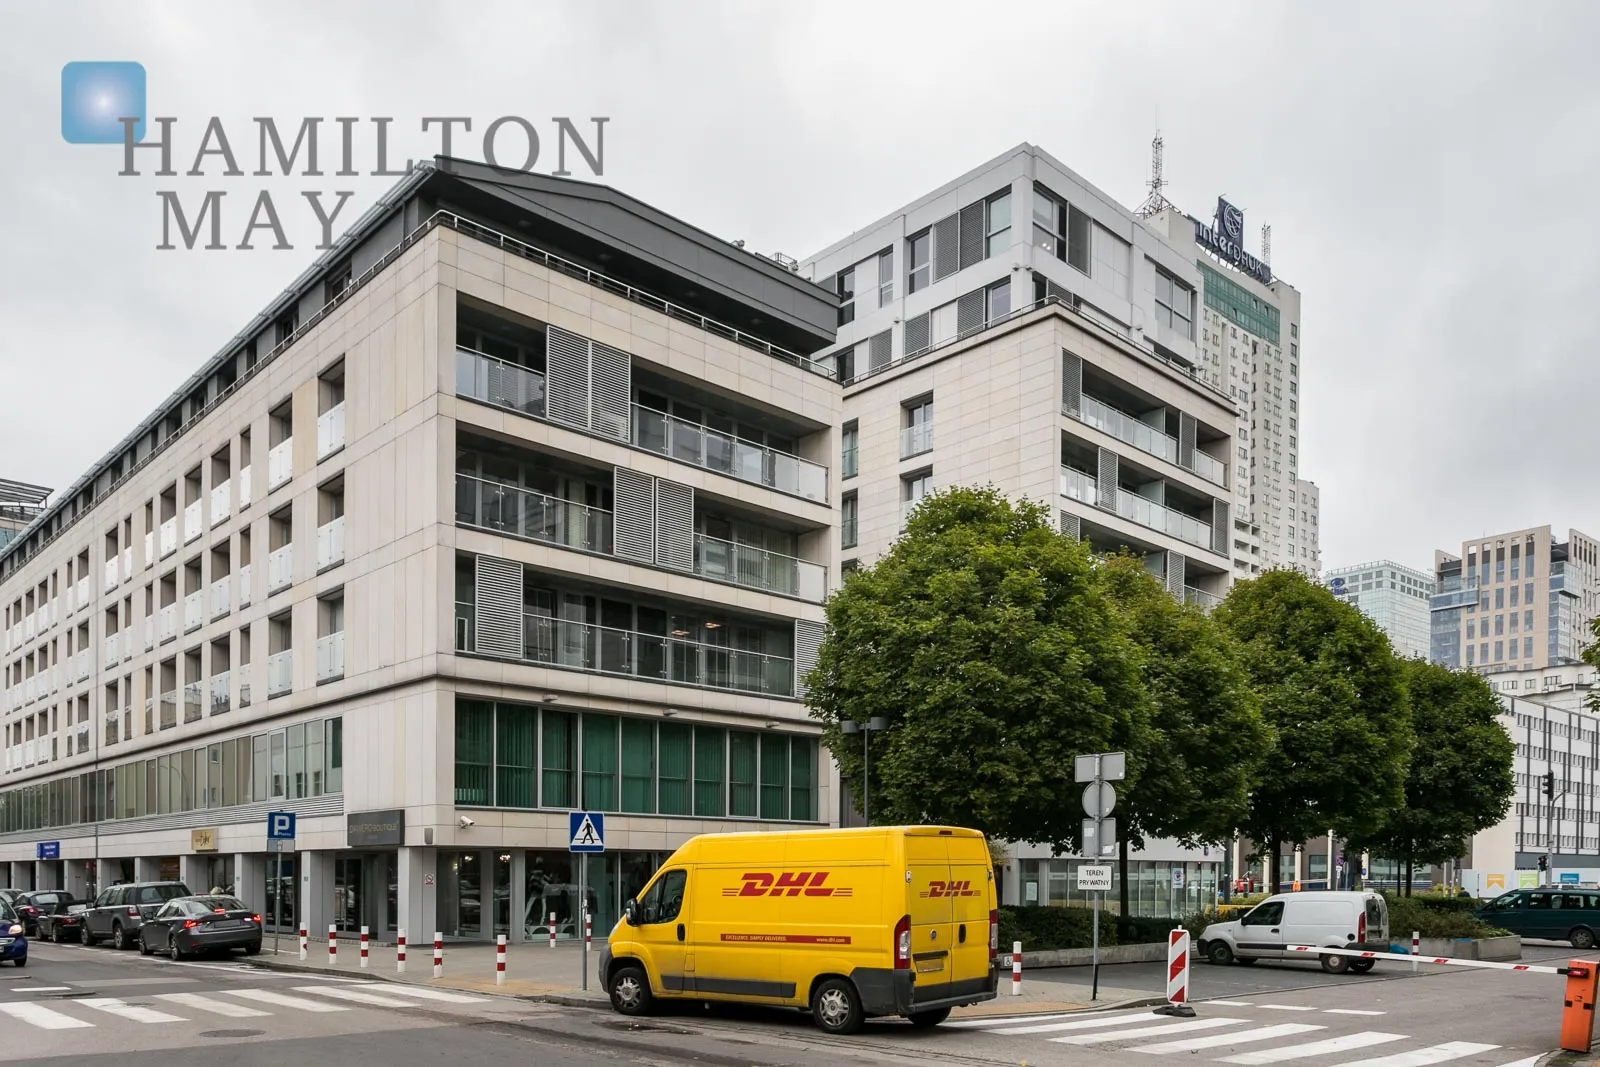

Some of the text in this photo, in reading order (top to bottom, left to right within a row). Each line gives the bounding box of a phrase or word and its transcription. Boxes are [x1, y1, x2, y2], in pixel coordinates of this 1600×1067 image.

[274, 816, 290, 836] P
[738, 872, 833, 897] DHL
[928, 881, 973, 898] DHL
